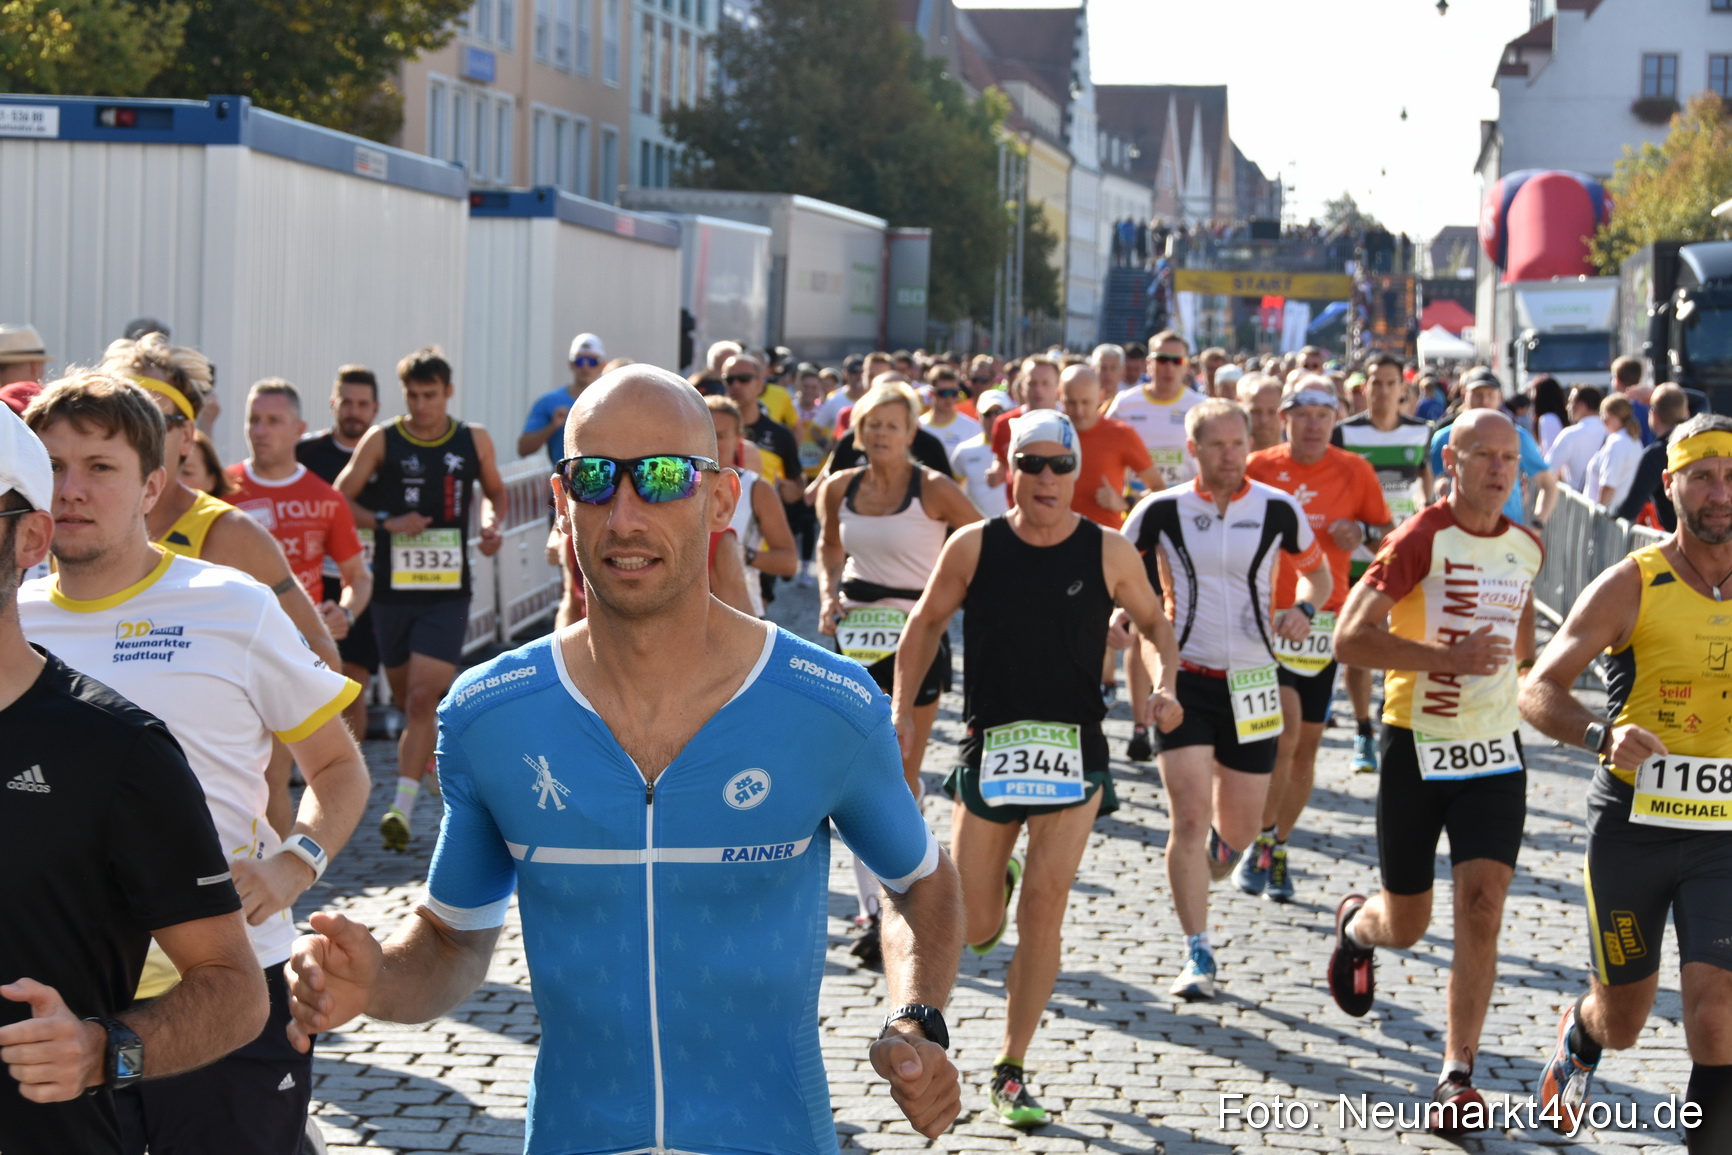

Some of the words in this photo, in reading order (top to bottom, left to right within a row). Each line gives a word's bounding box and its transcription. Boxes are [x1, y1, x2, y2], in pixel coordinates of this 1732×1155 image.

[1234, 276, 1292, 290] START
[401, 551, 453, 569] 1332
[118, 621, 151, 640] 20
[115, 638, 192, 650] Neumarkter
[112, 651, 175, 663] Stadtlauf
[1243, 689, 1277, 714] 115
[1659, 686, 1692, 699] Seidl
[992, 724, 1073, 749] BOCK
[993, 750, 1070, 777] 2344
[1430, 739, 1506, 770] 2805
[1652, 759, 1732, 795] 1168
[6, 781, 51, 793] adidas
[1006, 781, 1058, 797] PETER
[1650, 800, 1728, 818] MICHAEL
[721, 843, 795, 862] RAINER
[1616, 916, 1642, 954] Run!
